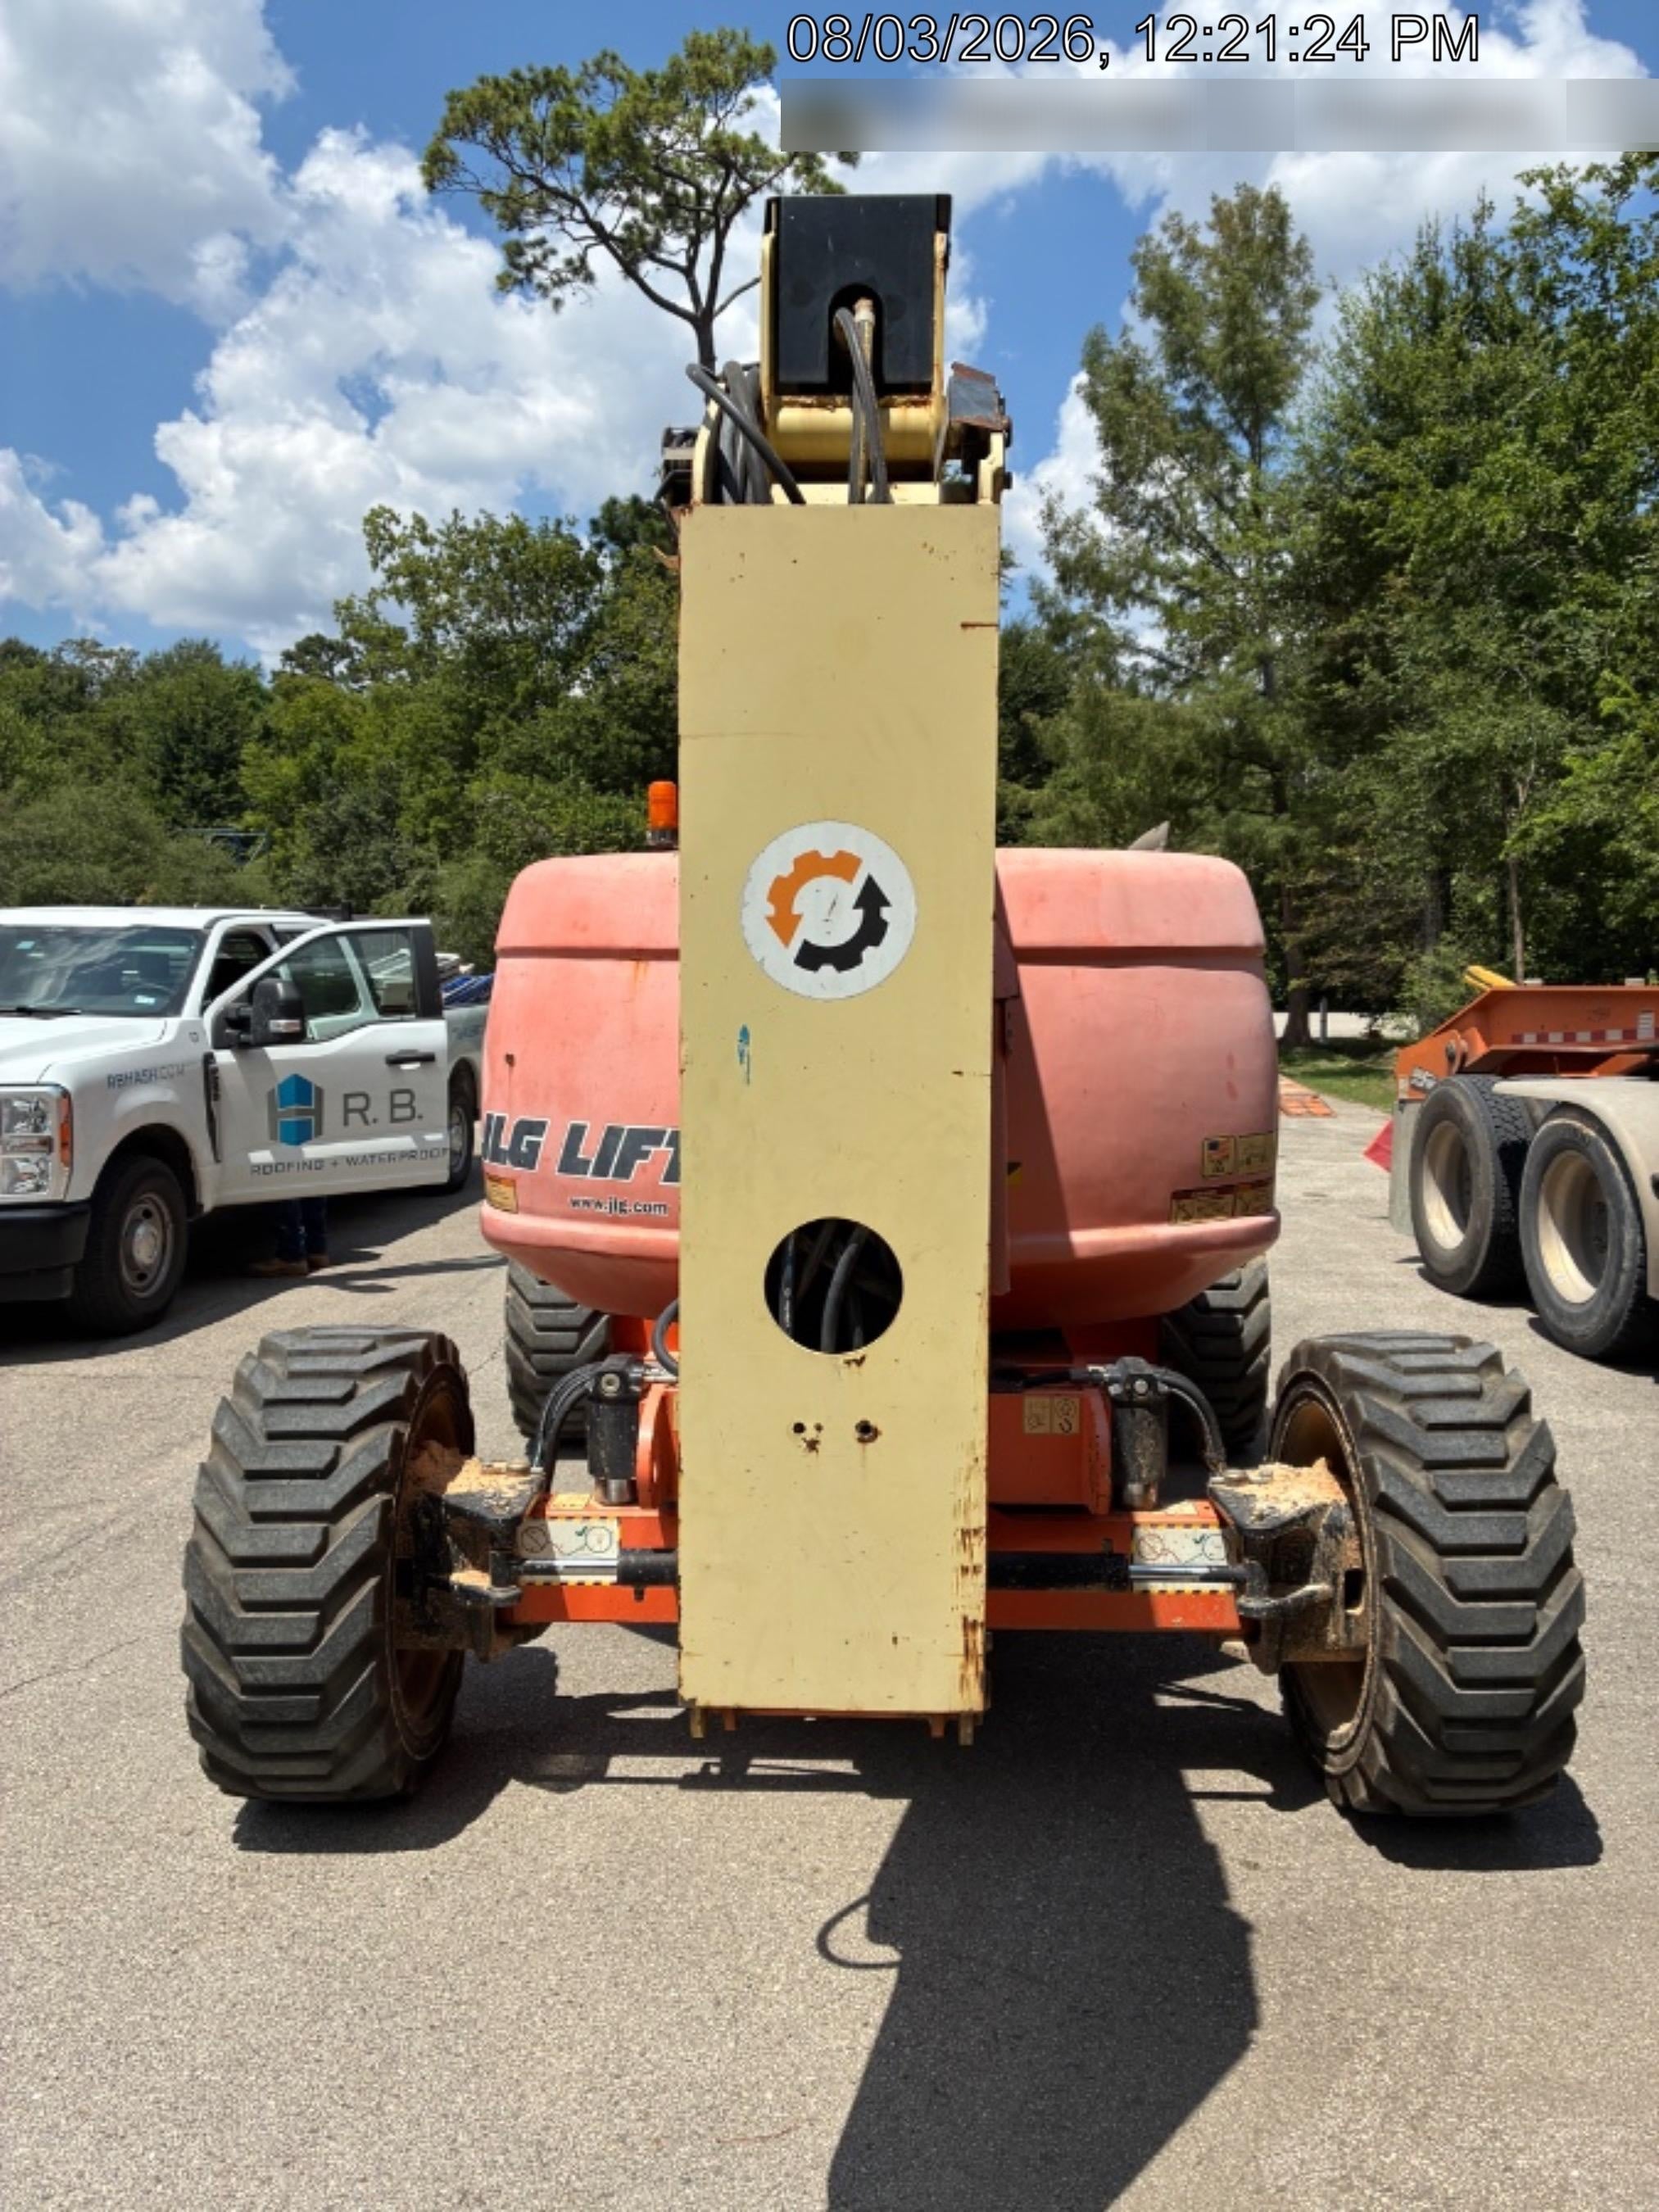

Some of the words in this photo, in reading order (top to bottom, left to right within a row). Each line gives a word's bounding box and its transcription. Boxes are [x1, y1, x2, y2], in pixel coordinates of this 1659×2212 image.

[342, 1091, 379, 1126] R.
[389, 1088, 424, 1123] B.
[250, 1159, 324, 1176] ROOFING
[569, 1195, 669, 1217] www.jlg.com
